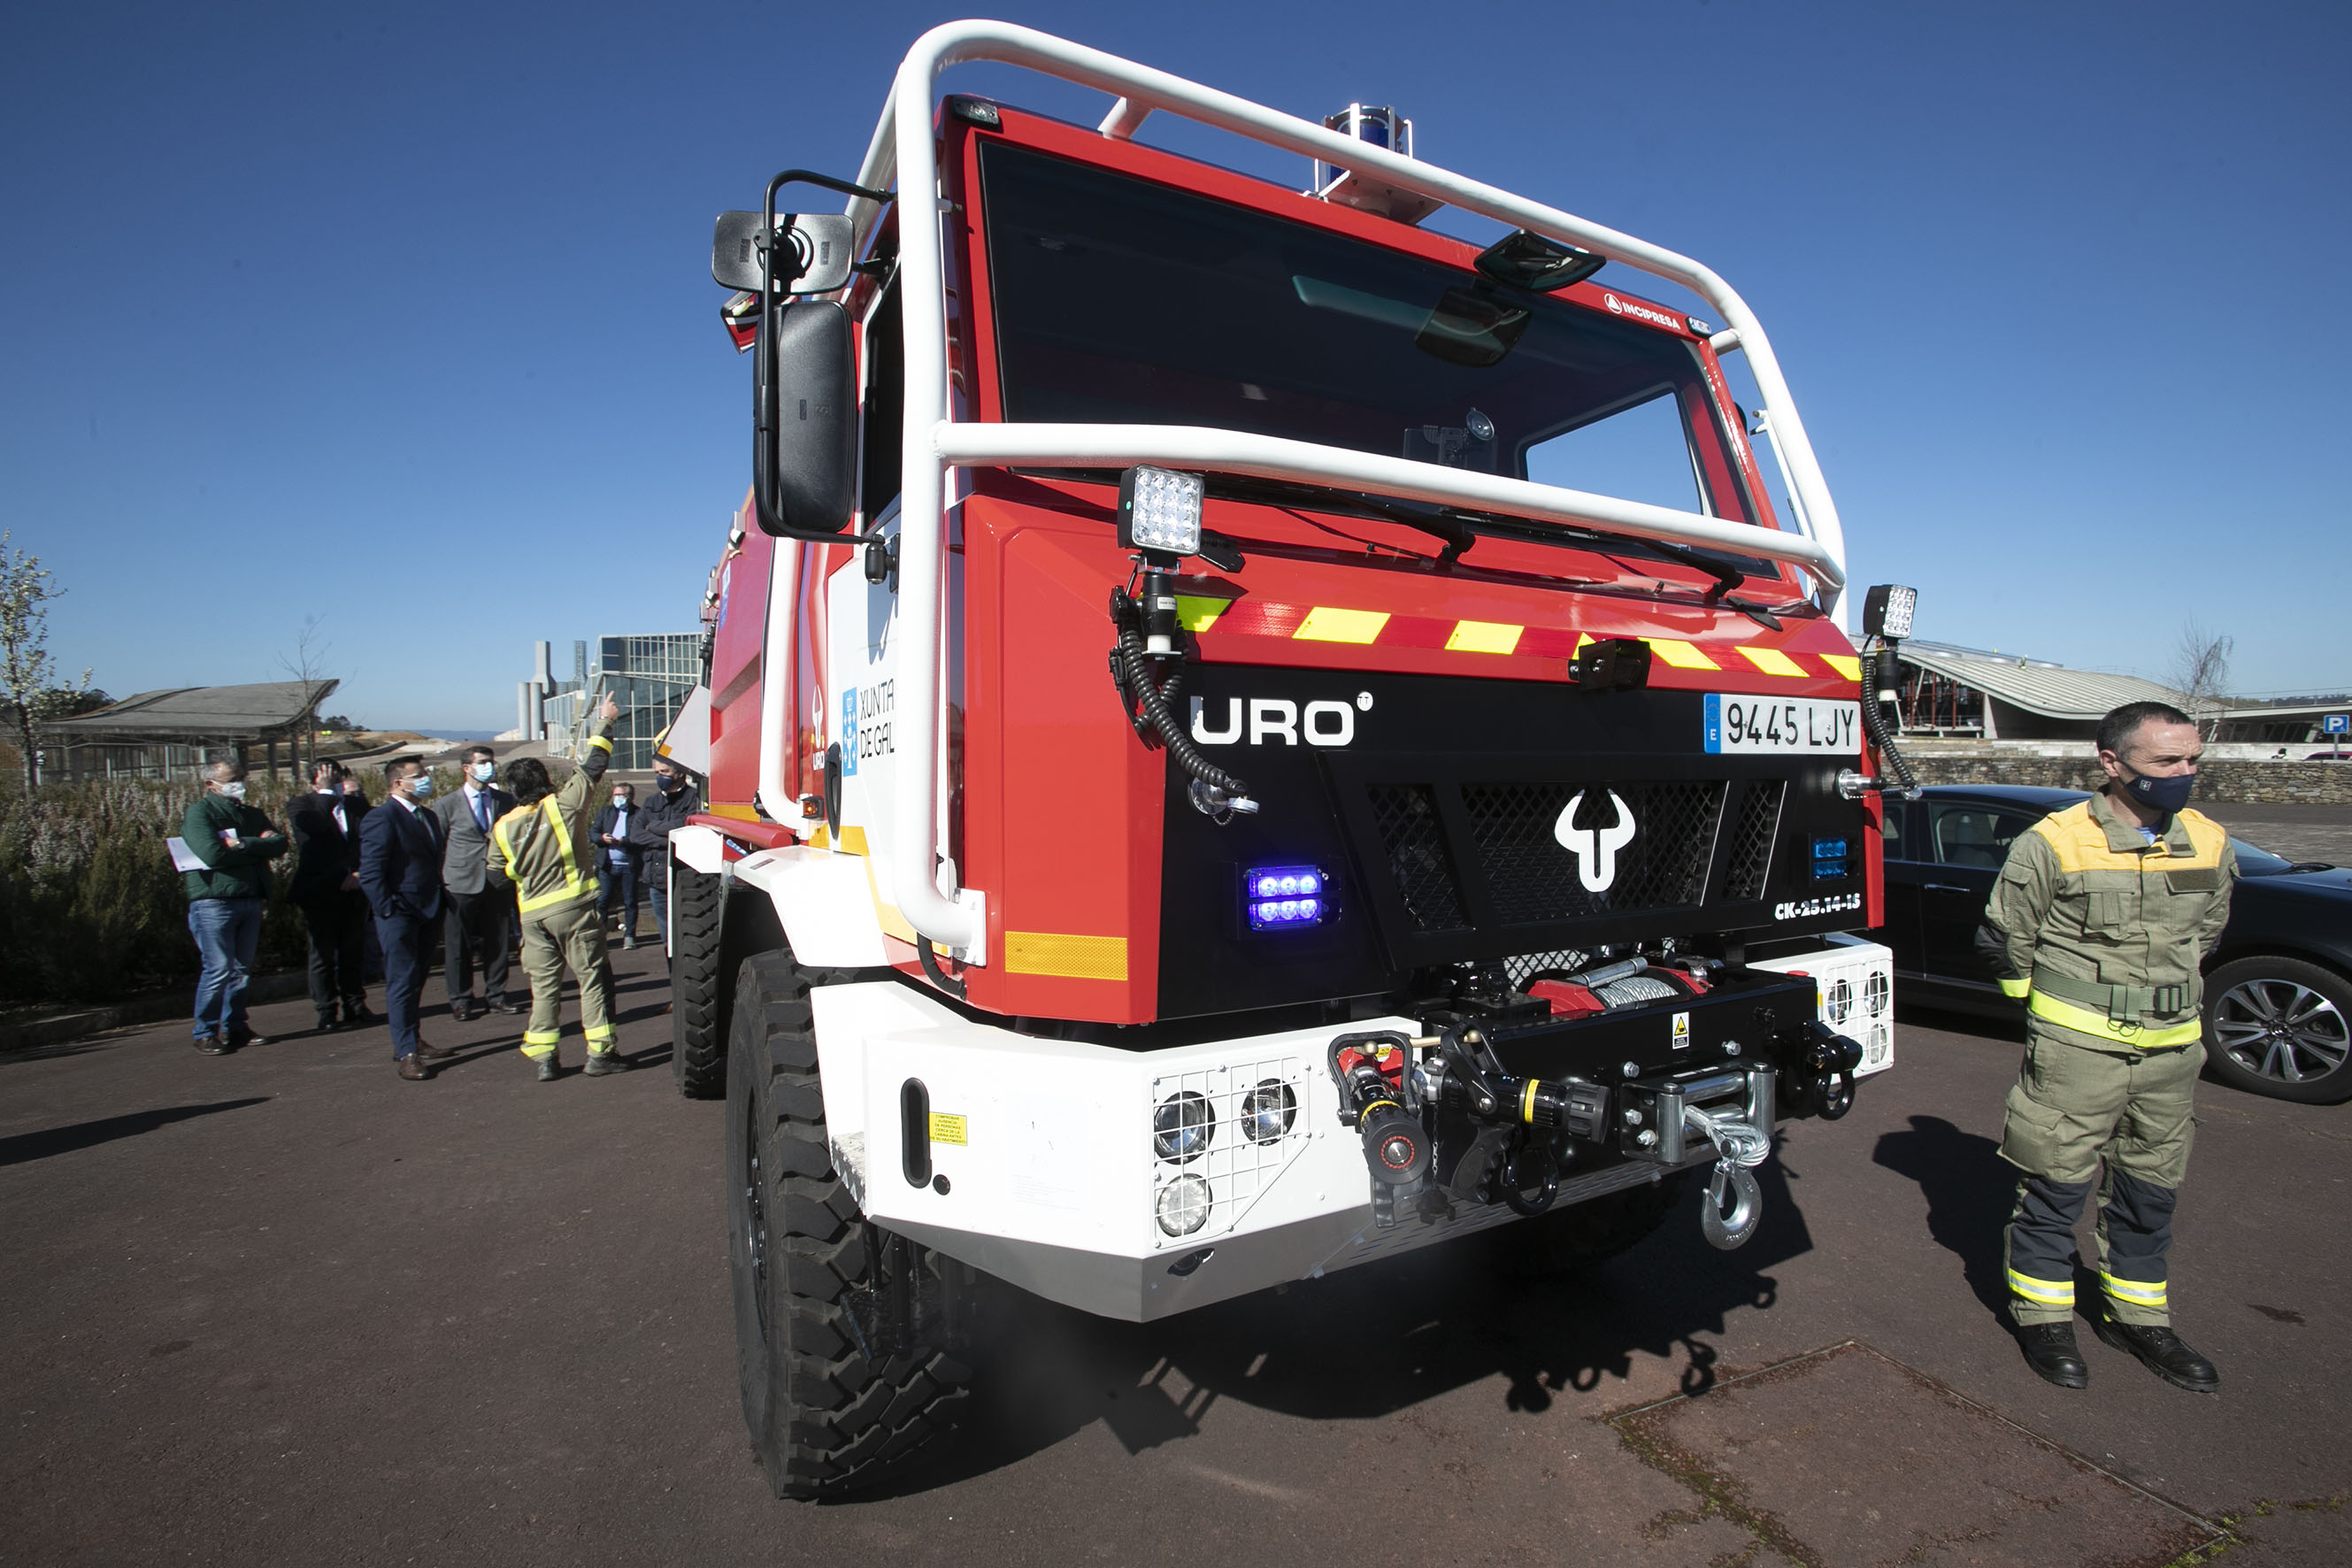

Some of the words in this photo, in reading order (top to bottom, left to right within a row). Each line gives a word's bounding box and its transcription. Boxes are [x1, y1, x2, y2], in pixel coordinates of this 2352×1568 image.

[1622, 302, 1680, 329] INCIPRESA
[860, 678, 895, 720] XUNTA
[1190, 696, 1355, 747] URO
[1710, 728, 1718, 741] E
[1727, 703, 1799, 746] 9445
[1809, 707, 1854, 747] LJY
[2328, 717, 2344, 732] P
[860, 727, 872, 758] DE
